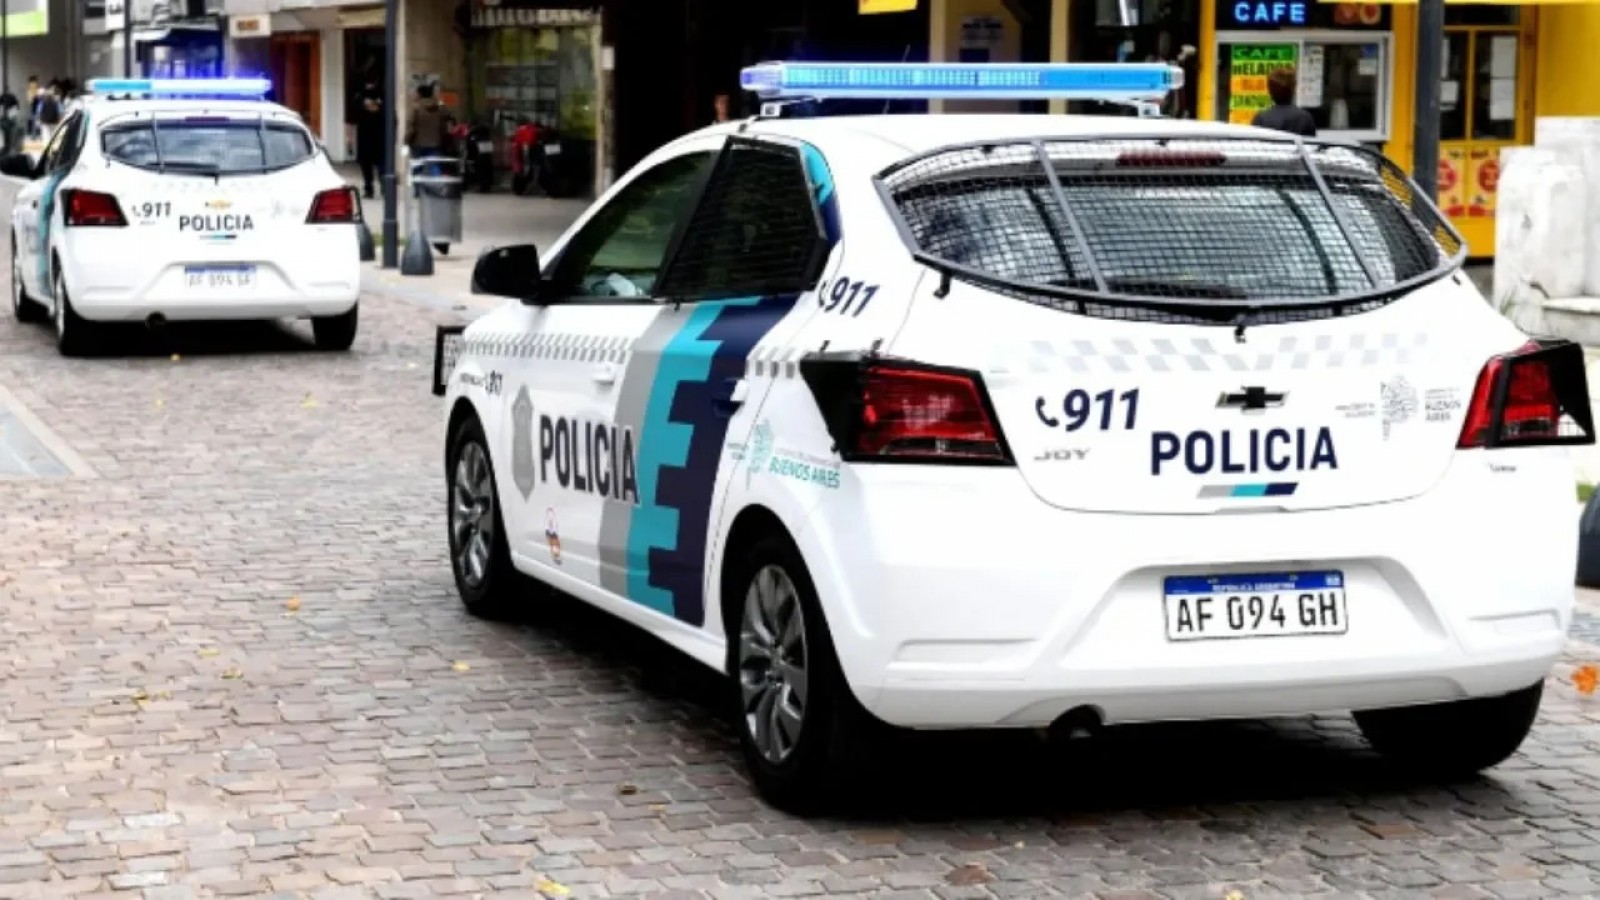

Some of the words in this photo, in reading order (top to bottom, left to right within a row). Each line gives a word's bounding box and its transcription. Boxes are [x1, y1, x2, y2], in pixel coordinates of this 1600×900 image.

[1234, 2, 1306, 22] CAFE
[142, 201, 171, 217] 911
[179, 214, 254, 231] POLICIA
[824, 276, 881, 317] 911
[1063, 388, 1139, 432] 911
[539, 414, 640, 505] POLICIA
[1034, 449, 1091, 461] JOY
[1151, 426, 1338, 475] POLICIA
[1177, 597, 1214, 632] AF
[1227, 595, 1286, 630] 094
[1299, 592, 1338, 628] GH
